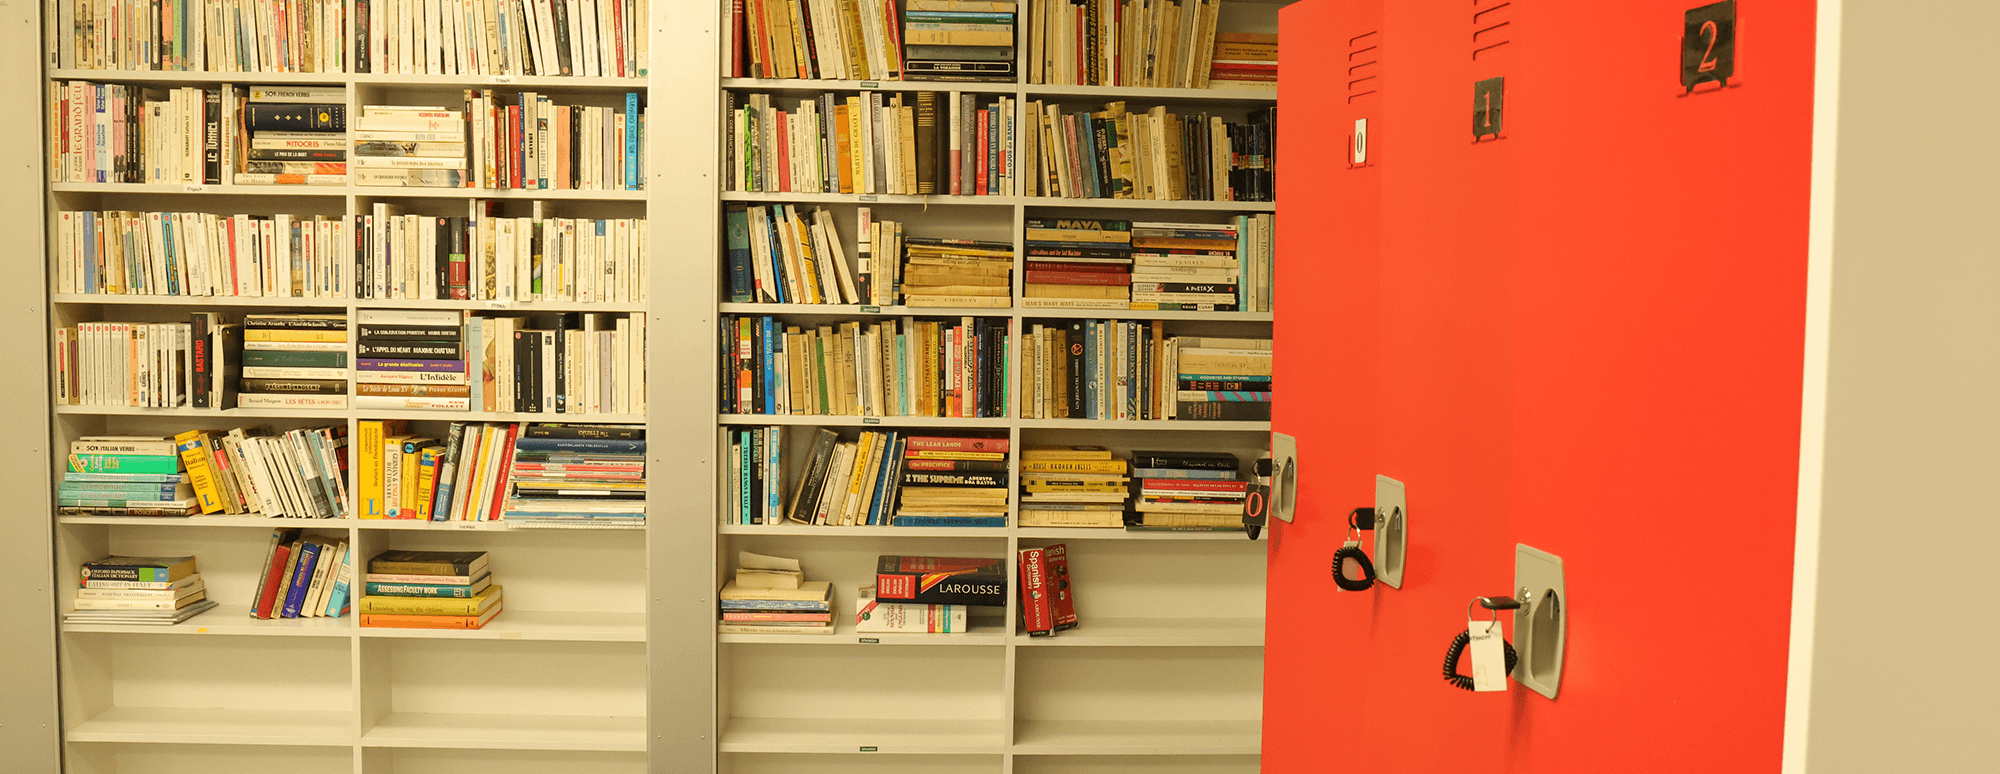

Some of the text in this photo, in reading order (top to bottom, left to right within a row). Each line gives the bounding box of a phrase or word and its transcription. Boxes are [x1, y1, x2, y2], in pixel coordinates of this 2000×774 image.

[1697, 20, 1717, 72] 2
[1483, 92, 1491, 127] 1
[205, 121, 217, 162] LE TUNNEL
[1056, 220, 1103, 231] MAYA
[196, 339, 204, 372] BASTARD
[420, 373, 457, 381] L'Infidèle
[912, 474, 929, 483] THE
[929, 474, 964, 484] SUPREME
[1246, 492, 1263, 517] 0
[1030, 551, 1041, 589] Spanish
[377, 585, 404, 593] ASSESSING
[404, 585, 423, 594] FACULTY
[939, 583, 1000, 595] LAROUSSE
